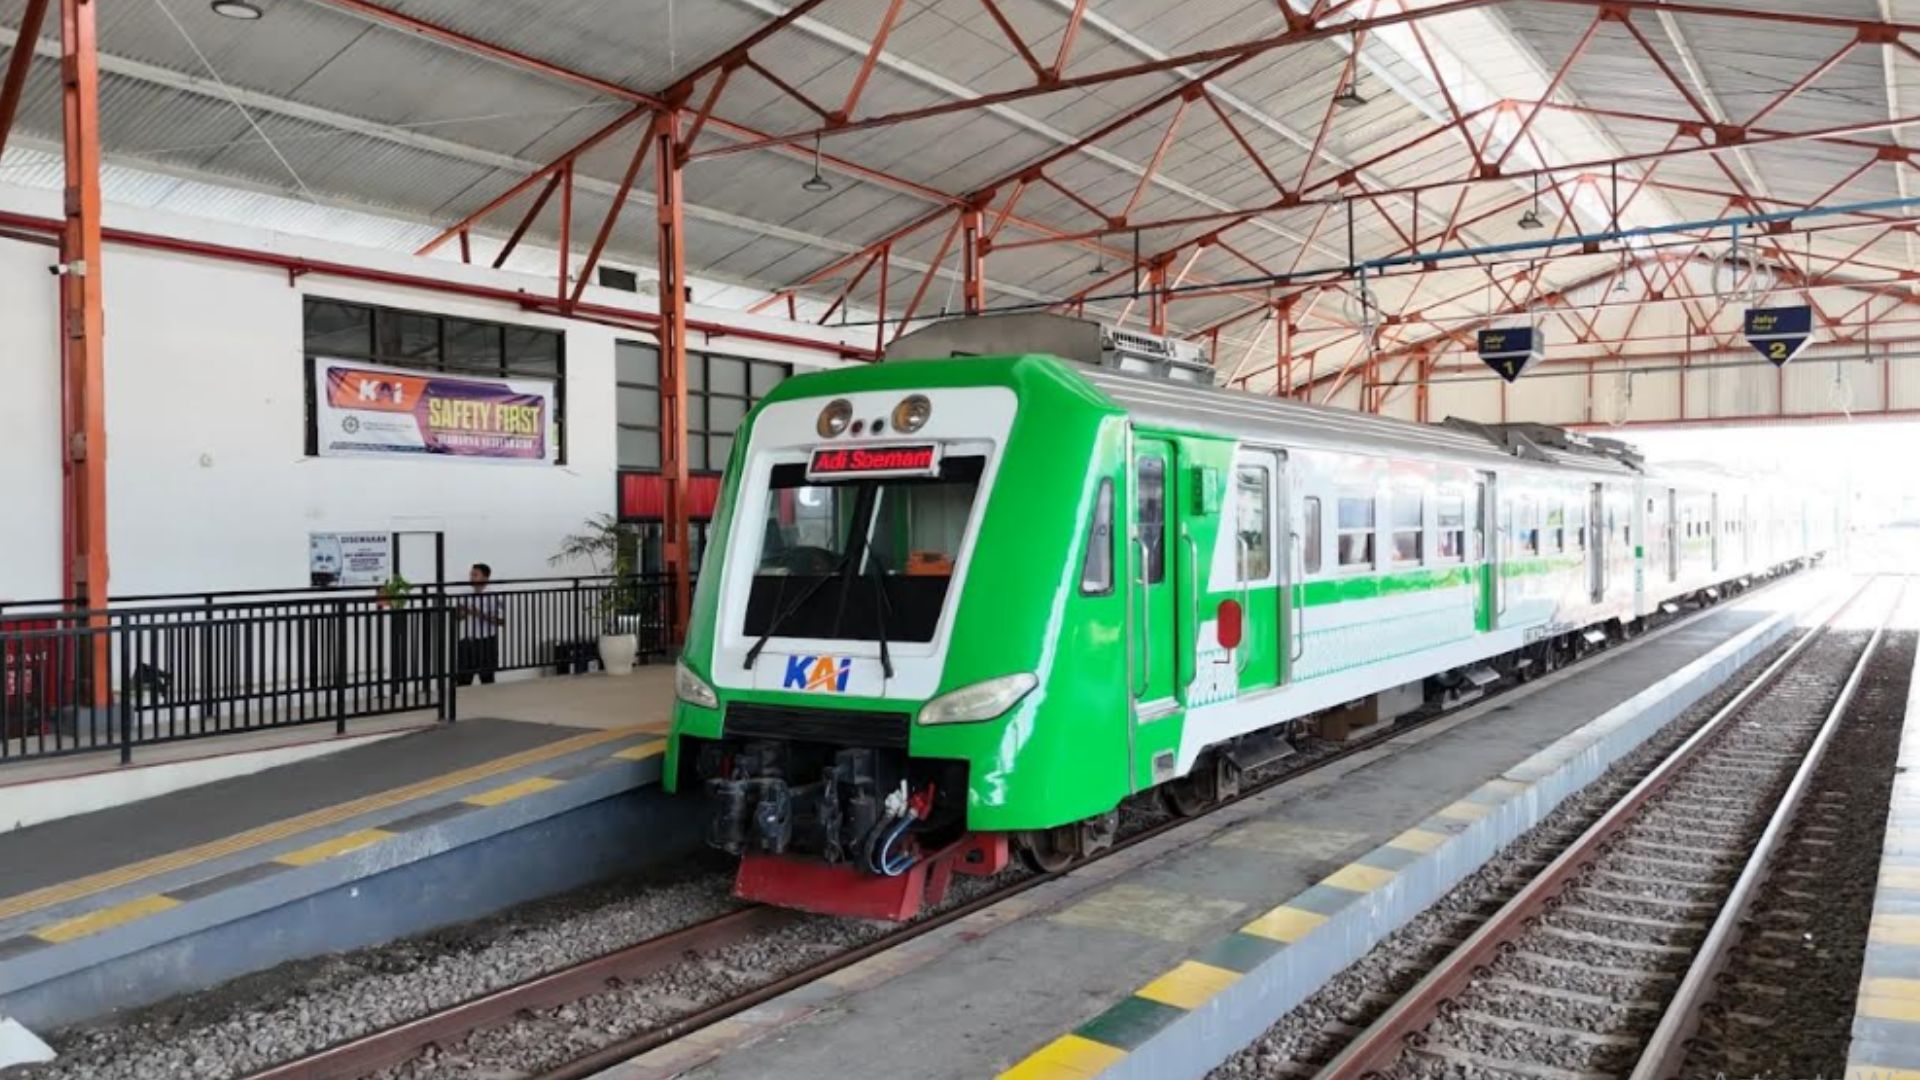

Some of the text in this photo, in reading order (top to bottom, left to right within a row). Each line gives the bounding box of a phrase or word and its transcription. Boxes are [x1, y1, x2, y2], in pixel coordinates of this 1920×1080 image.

[1769, 341, 1787, 359] 2
[1502, 360, 1514, 375] 1
[429, 398, 540, 433] SAFETY FIRST
[815, 451, 847, 470] Adi
[784, 654, 852, 692] KAI
